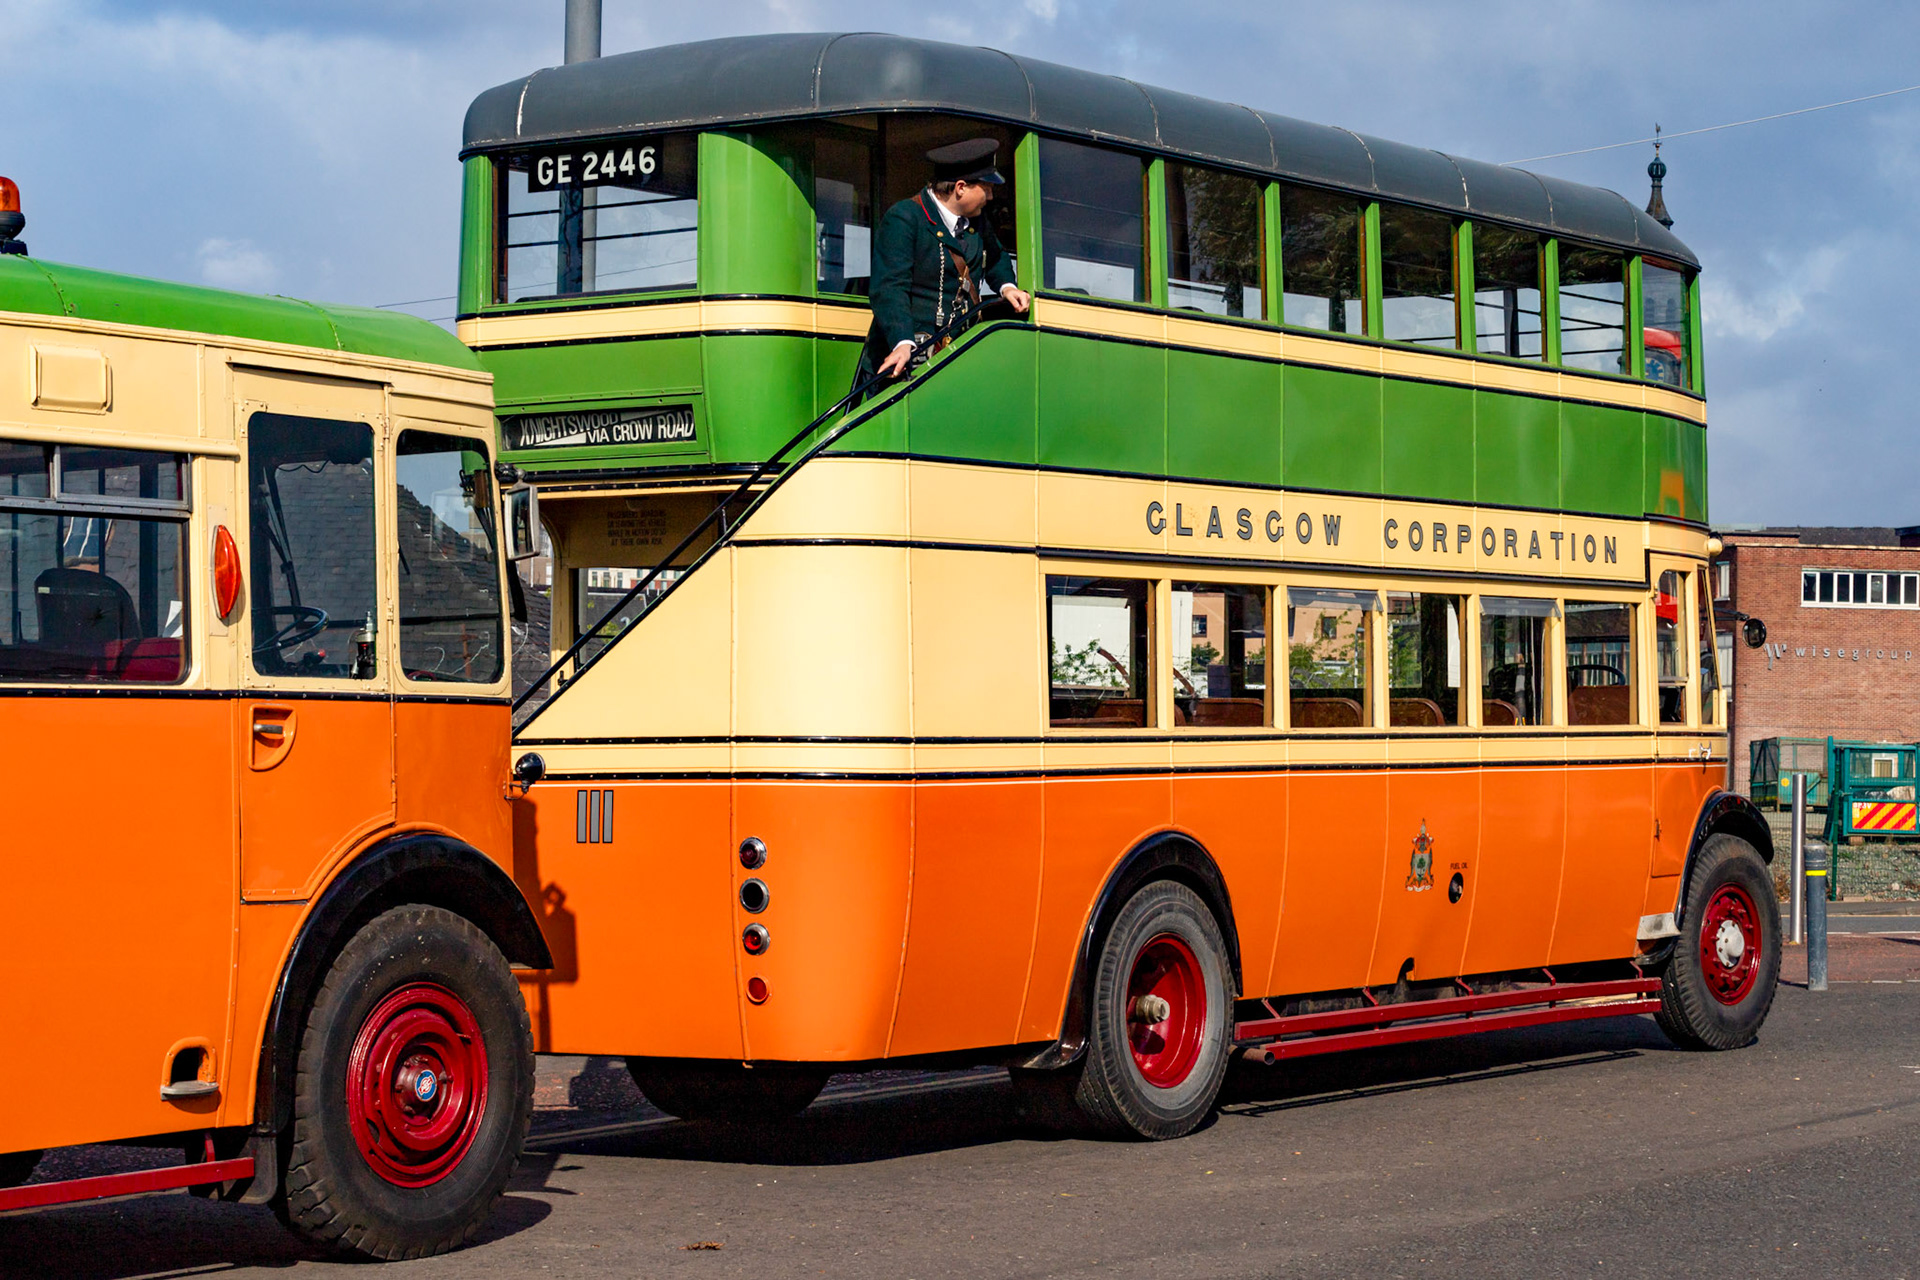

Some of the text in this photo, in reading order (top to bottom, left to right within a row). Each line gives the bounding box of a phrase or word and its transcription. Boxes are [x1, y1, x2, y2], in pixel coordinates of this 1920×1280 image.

[537, 146, 656, 186] GE 2446
[520, 412, 619, 446] KNIGHTSWOOD
[587, 410, 695, 443] VIA CROW ROAD
[1146, 501, 1617, 564] GLASGOW CORPORATION
[1795, 645, 1912, 662] wisegroup
